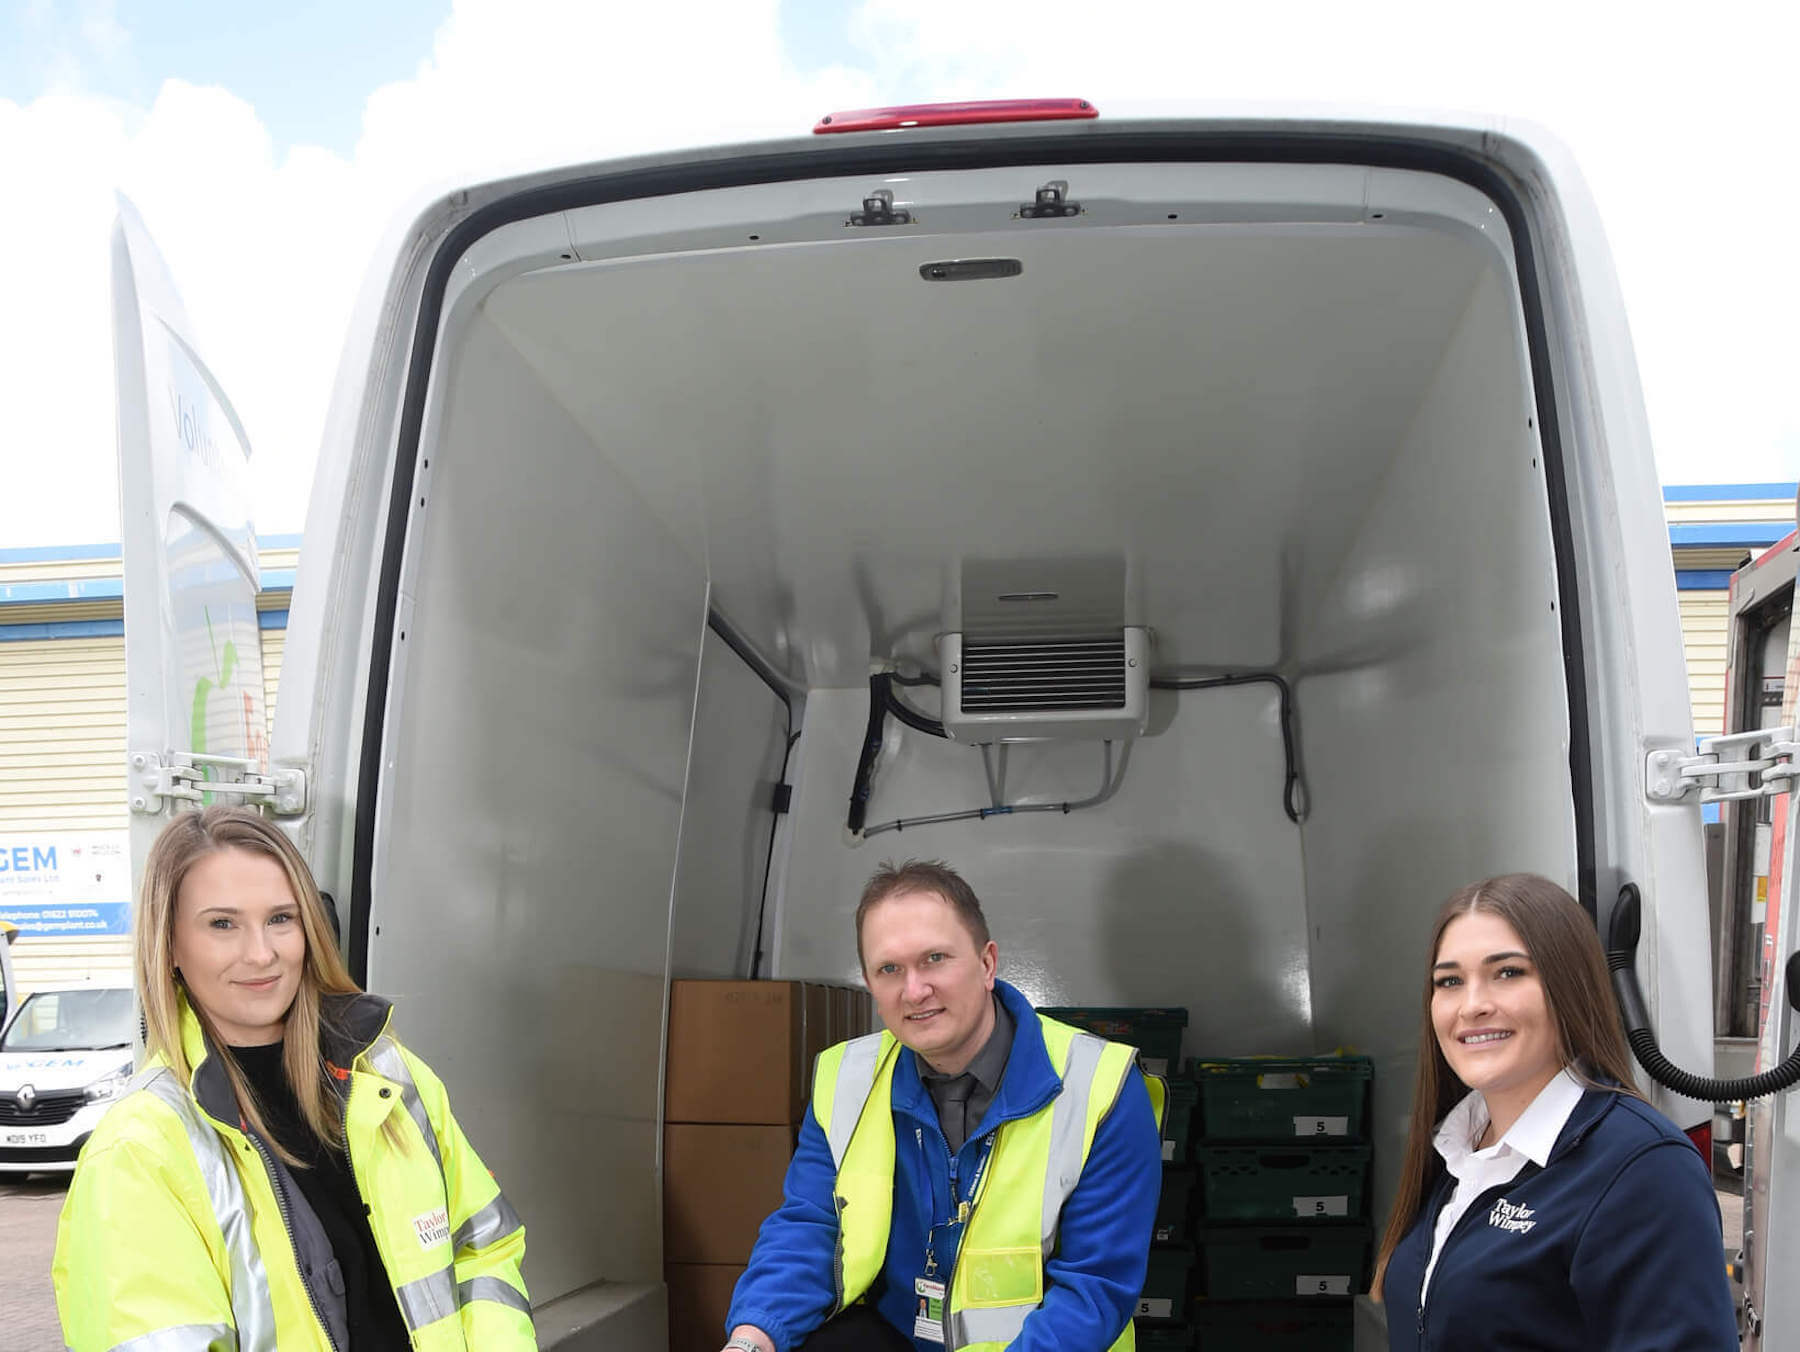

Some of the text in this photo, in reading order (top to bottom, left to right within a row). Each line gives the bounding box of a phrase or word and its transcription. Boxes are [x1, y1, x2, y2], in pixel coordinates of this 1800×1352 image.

[1316, 1121, 1325, 1132] 5
[1315, 1201, 1325, 1212] 5
[1494, 1198, 1536, 1220] Taylor
[414, 1210, 447, 1233] Taylor
[1488, 1211, 1537, 1234] Wimpey
[1319, 1281, 1328, 1292] 5
[1141, 1303, 1149, 1313] 5
